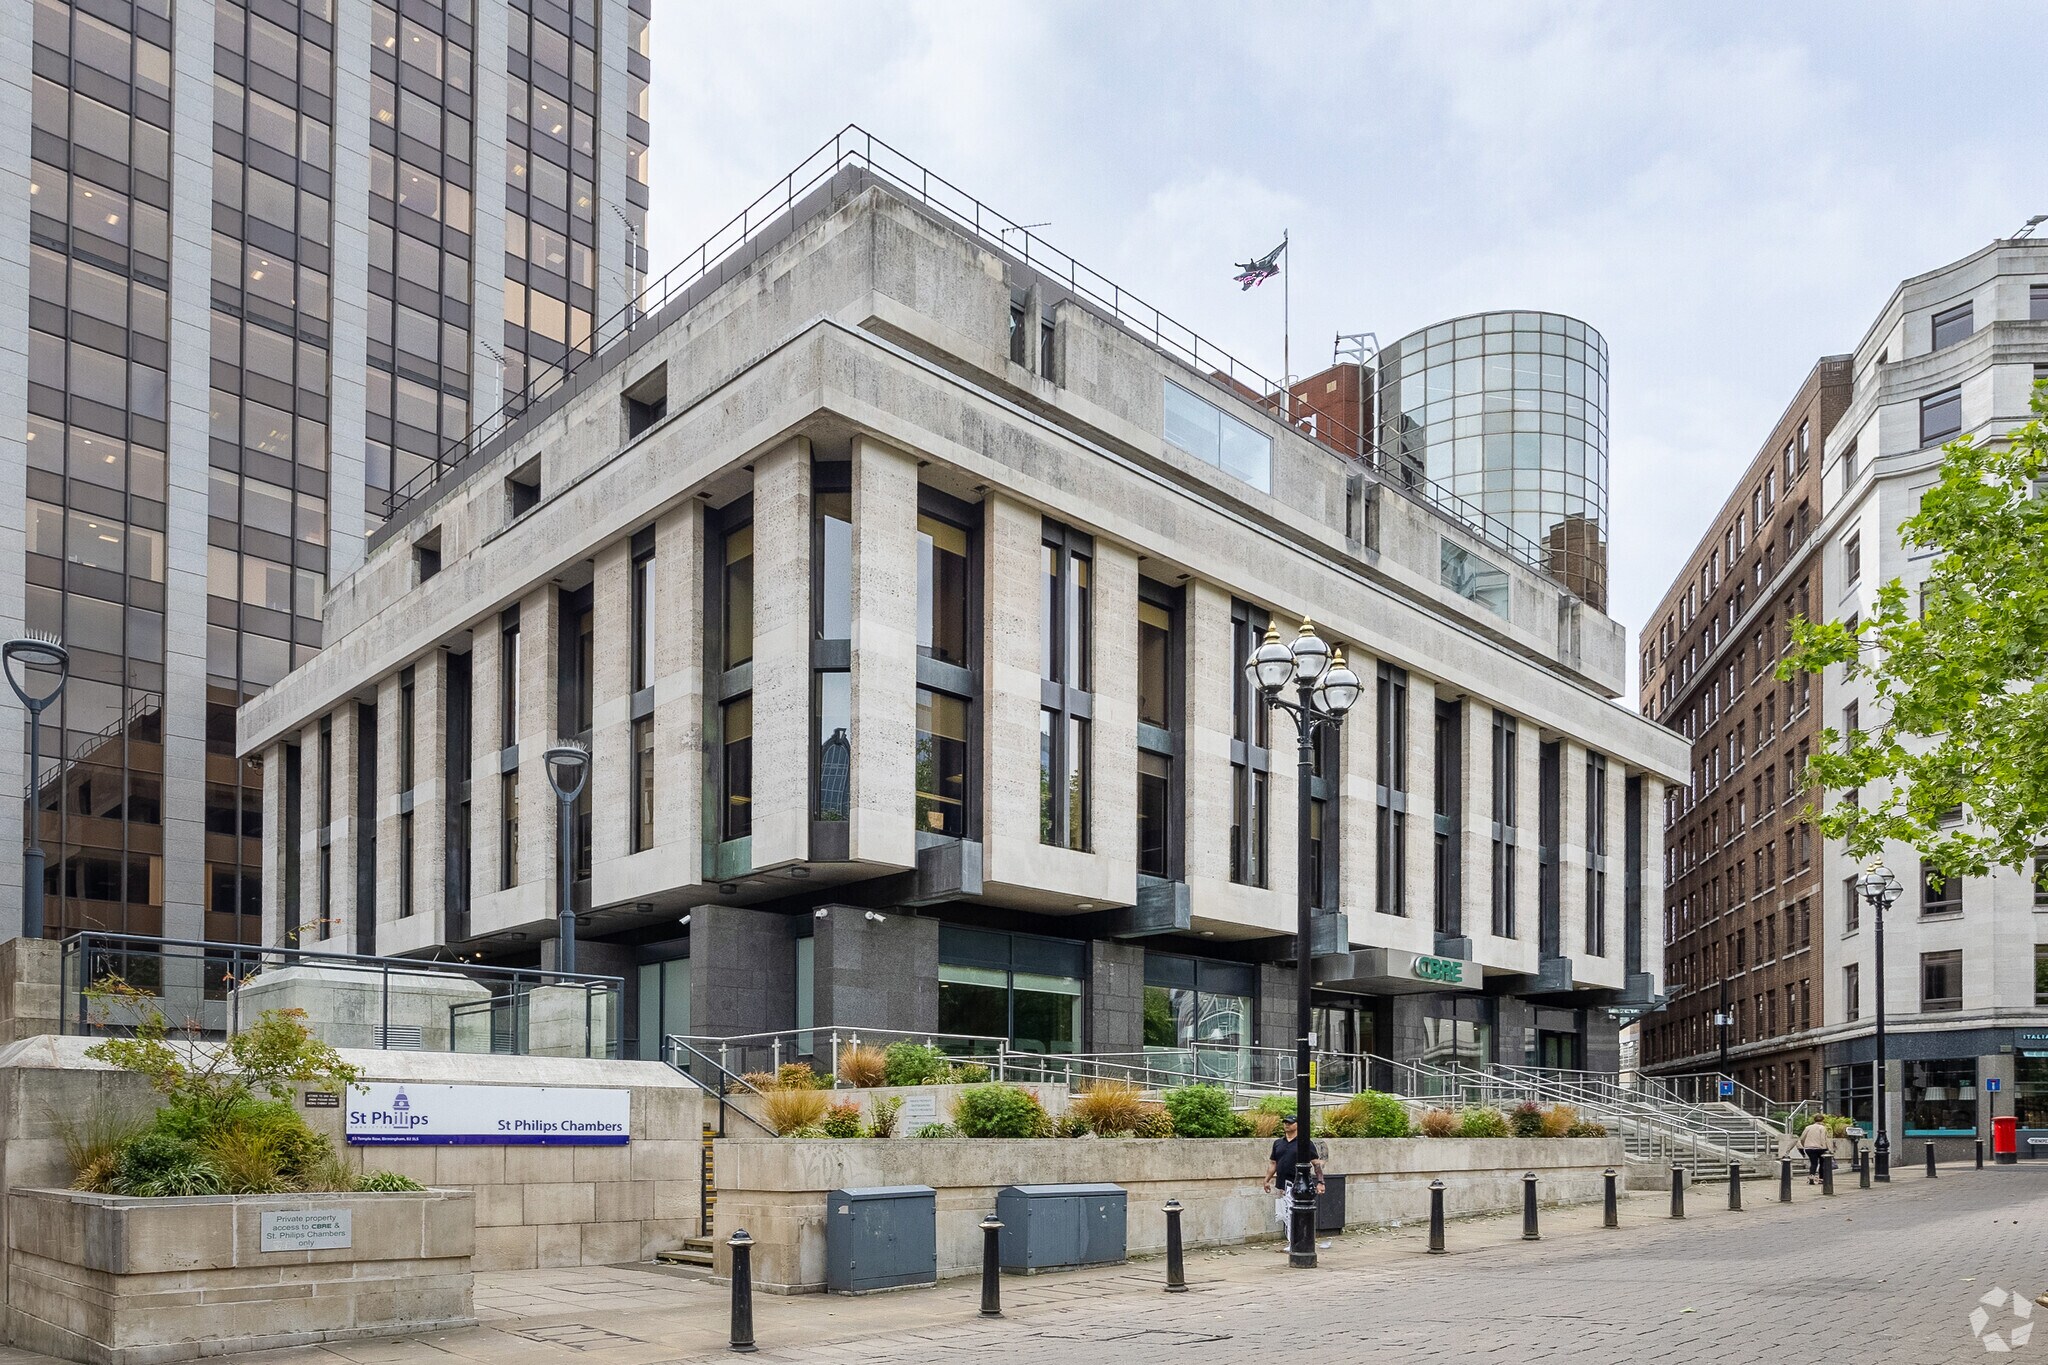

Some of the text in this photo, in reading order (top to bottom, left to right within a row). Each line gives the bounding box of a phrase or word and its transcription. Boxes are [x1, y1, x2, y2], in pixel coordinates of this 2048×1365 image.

[1415, 956, 1463, 984] CBRE
[350, 1111, 429, 1129] St Philips
[497, 1119, 623, 1133] St Philips Chambers
[305, 1215, 336, 1223] property
[307, 1230, 346, 1238] Chambers
[298, 1240, 315, 1248] only
